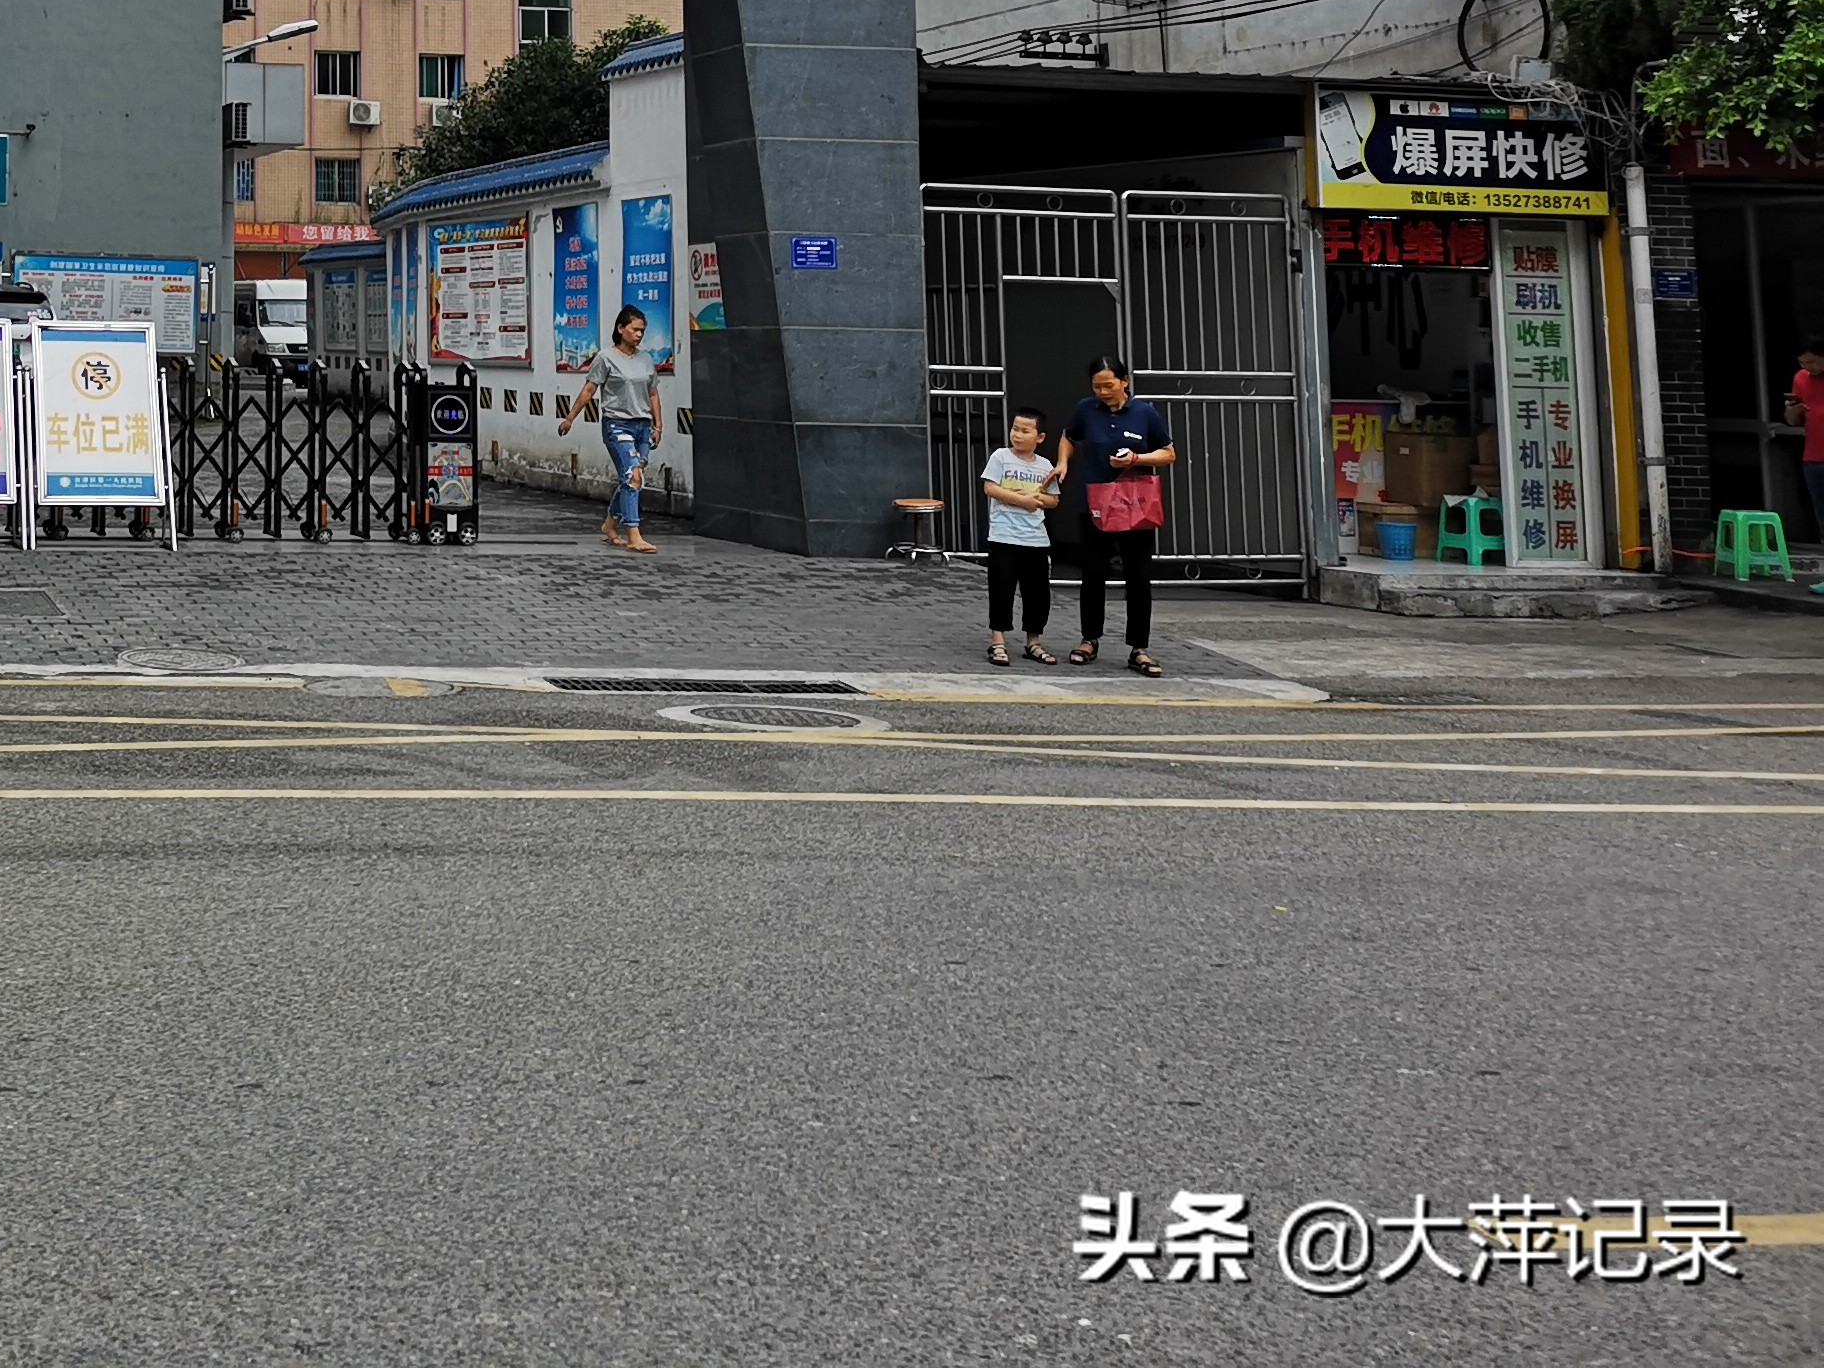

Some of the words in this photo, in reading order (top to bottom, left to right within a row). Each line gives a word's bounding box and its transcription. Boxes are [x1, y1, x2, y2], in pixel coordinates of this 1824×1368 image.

[1391, 125, 1590, 181] 爆屏快修
[1512, 245, 1560, 274] 贴膜
[1514, 283, 1562, 311] 刷机
[1516, 319, 1562, 349] 收售
[1513, 354, 1570, 383] 二手机
[46, 412, 150, 456] 车位已满
[1516, 399, 1547, 551] 手机维修
[1548, 399, 1579, 551] 专业换屏
